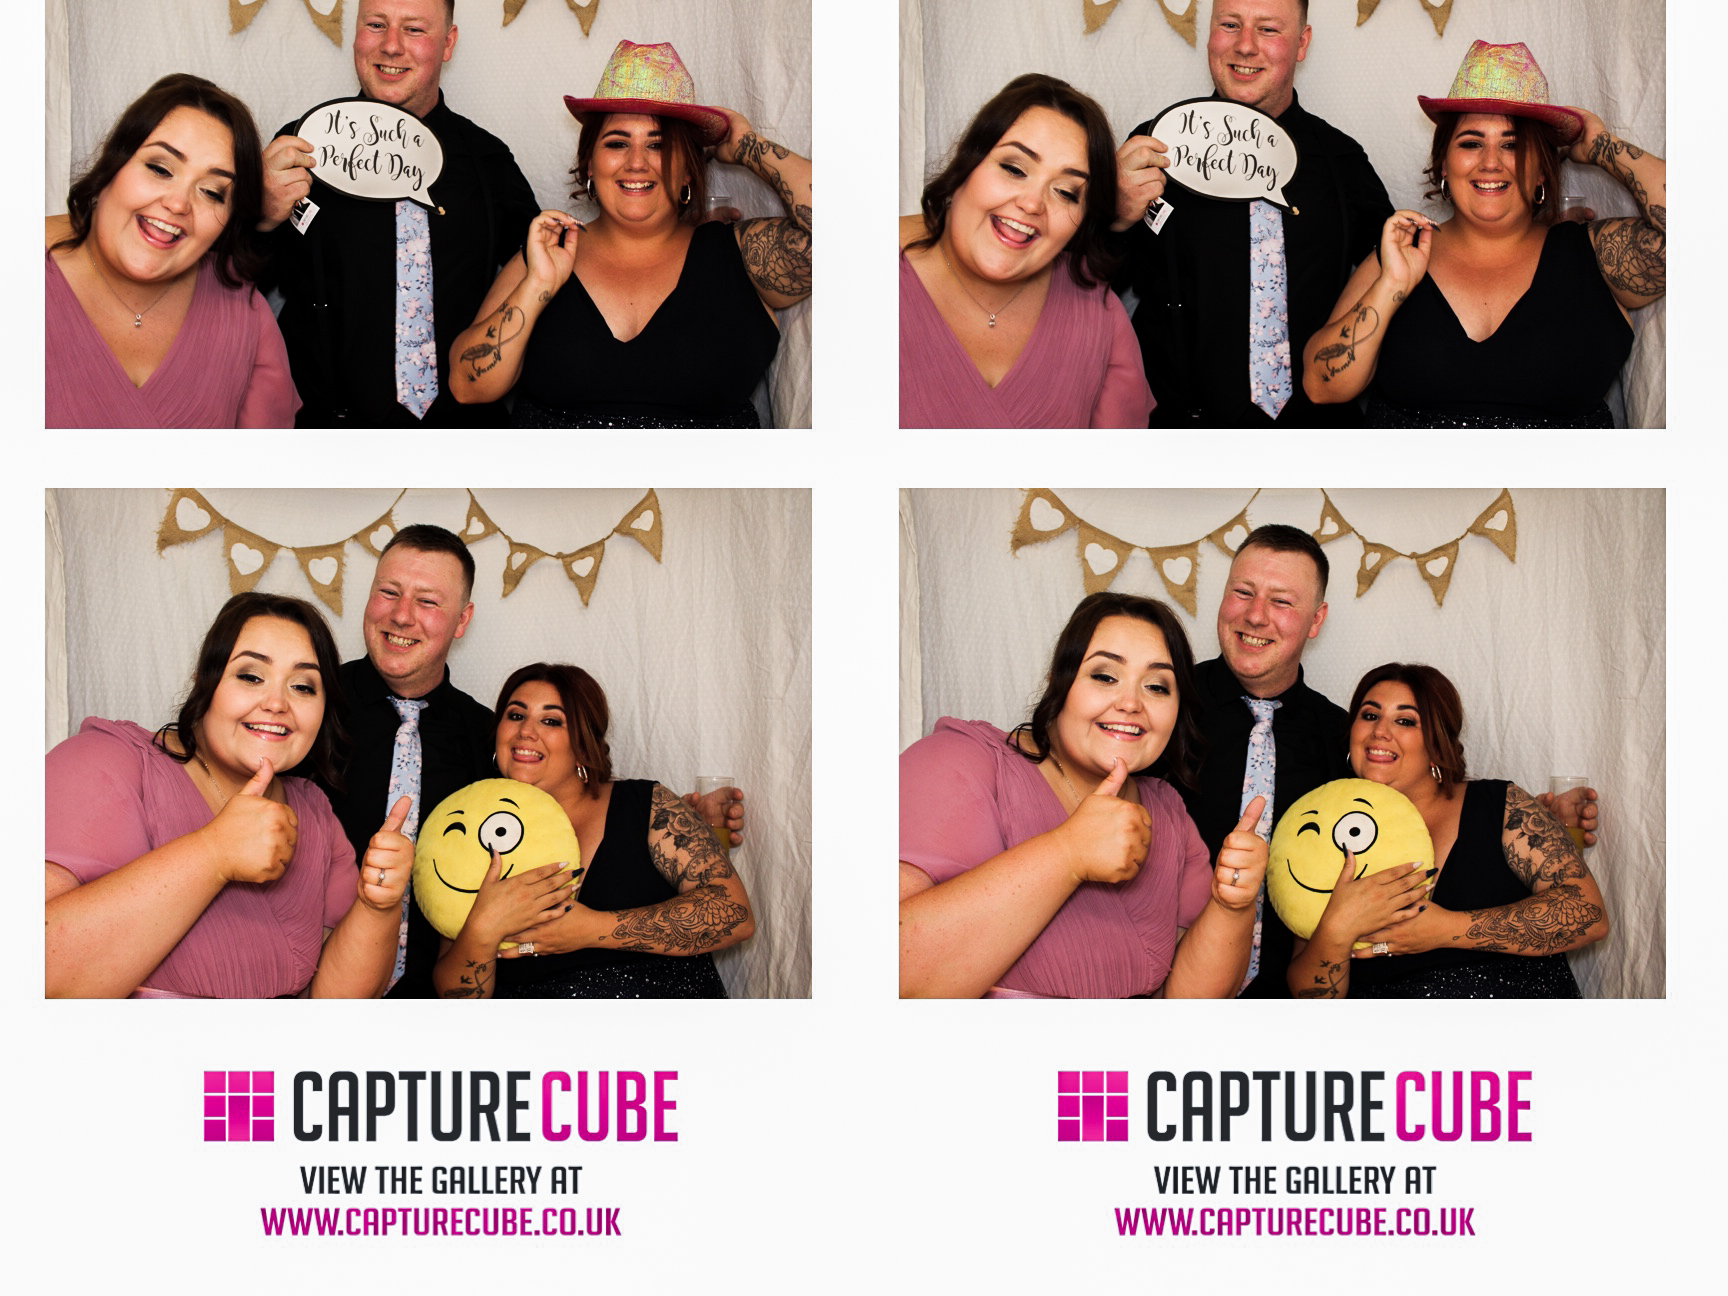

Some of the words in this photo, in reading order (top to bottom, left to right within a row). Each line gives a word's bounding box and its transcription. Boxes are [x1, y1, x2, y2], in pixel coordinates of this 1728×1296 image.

[324, 109, 360, 140] It's
[363, 114, 409, 149] Such
[413, 134, 425, 148] a
[1178, 109, 1214, 140] It's
[1217, 114, 1263, 149] Such
[1267, 134, 1279, 148] a
[318, 143, 383, 181] Perfect
[385, 152, 426, 191] Day
[1172, 143, 1237, 181] Perfect
[1239, 152, 1280, 191] Day
